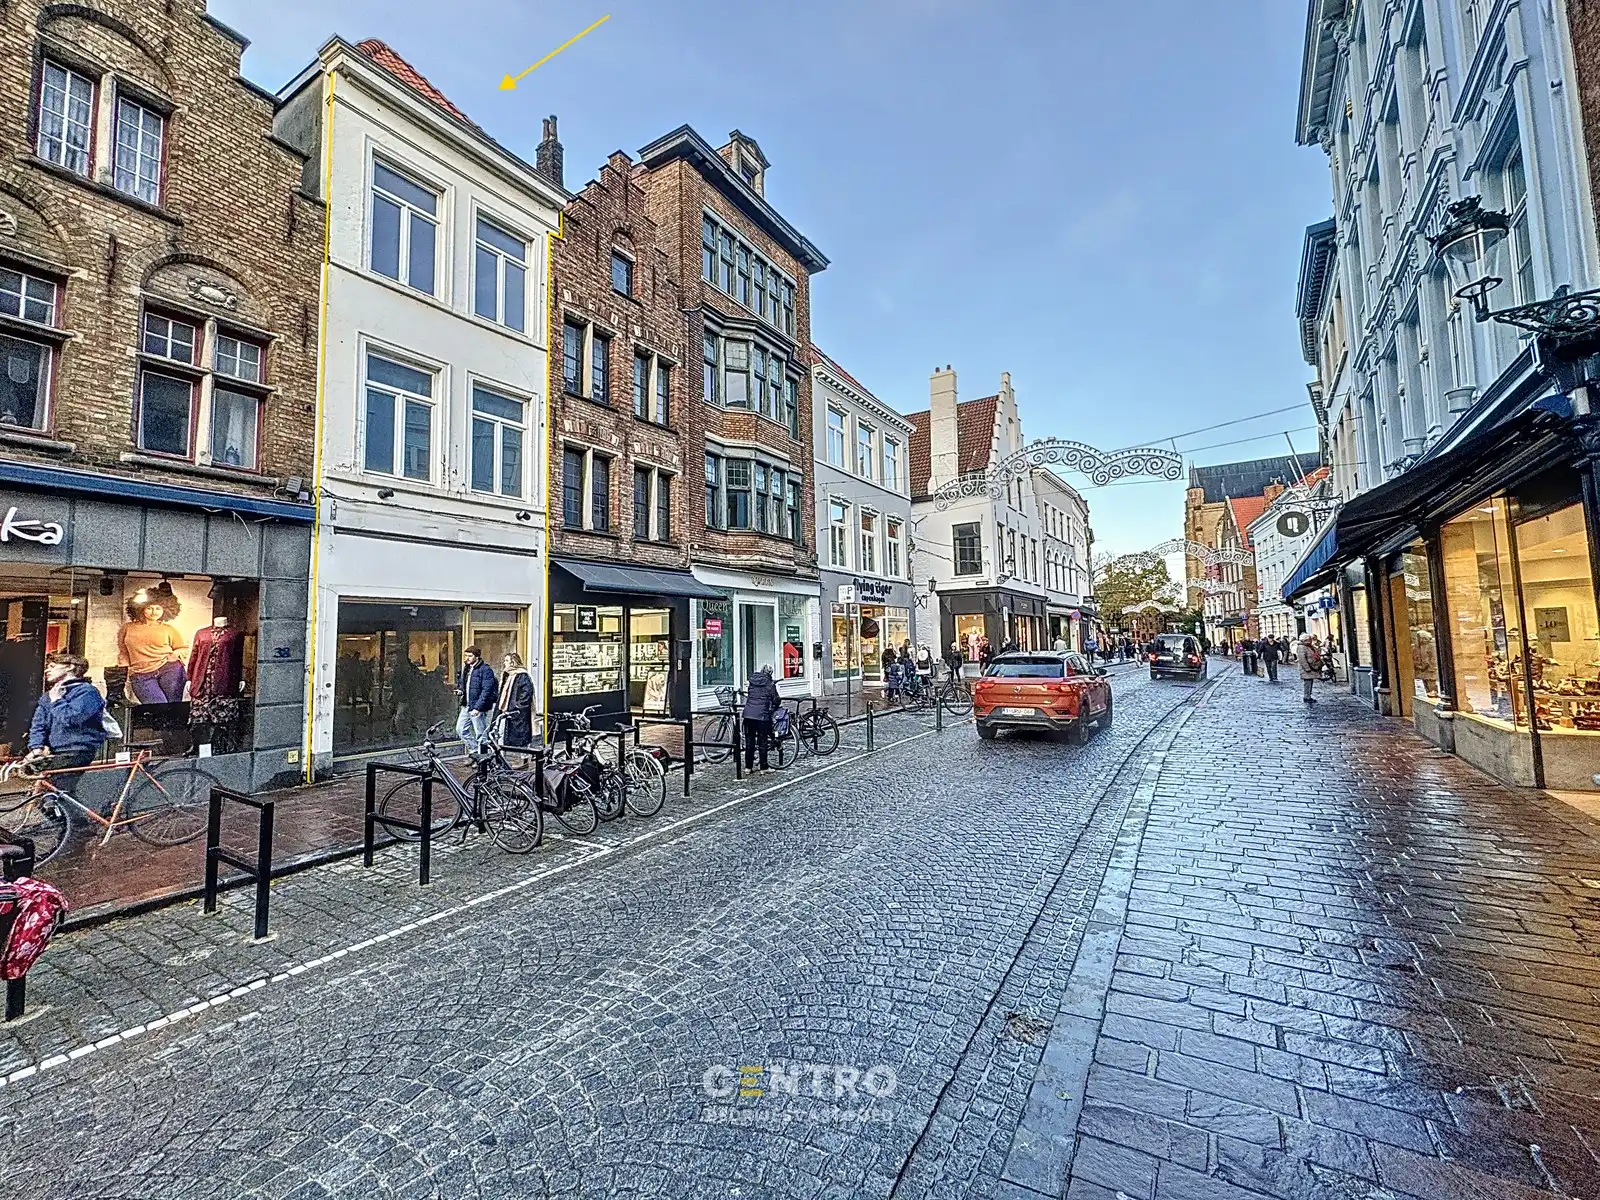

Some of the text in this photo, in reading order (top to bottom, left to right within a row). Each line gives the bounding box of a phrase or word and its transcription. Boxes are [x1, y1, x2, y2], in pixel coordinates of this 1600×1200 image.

[847, 586, 853, 595] P
[853, 577, 874, 595] flying
[874, 581, 893, 597] tiger
[700, 600, 728, 616] Queen
[272, 647, 291, 658] 38
